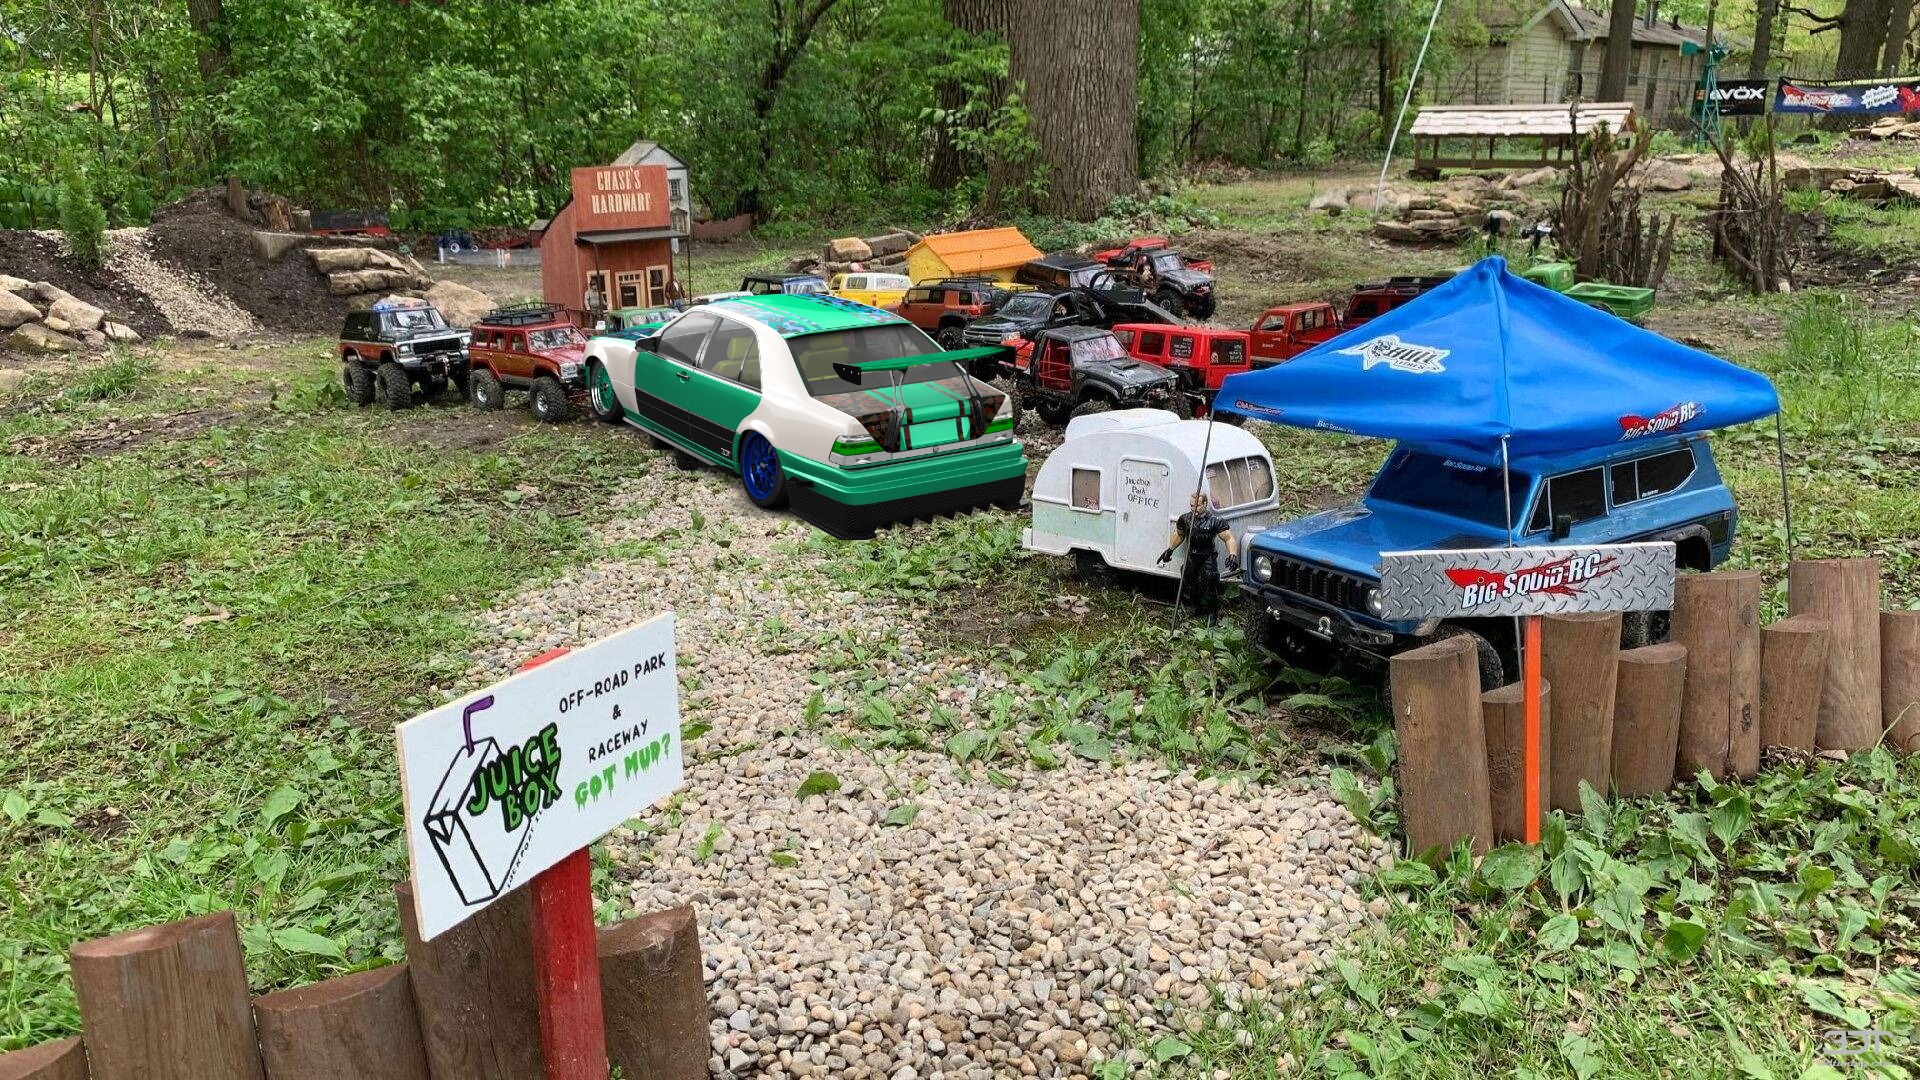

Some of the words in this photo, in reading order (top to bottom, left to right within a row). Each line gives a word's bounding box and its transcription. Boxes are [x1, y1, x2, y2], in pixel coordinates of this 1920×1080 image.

[591, 192, 651, 214] HARDWARE
[596, 165, 641, 190] CHASE'S
[1127, 493, 1160, 509] OFFICE
[1460, 582, 1498, 610] BIG
[1567, 552, 1601, 584] RC
[559, 669, 629, 714] OFF-ROAD
[634, 651, 667, 679] PARK
[612, 703, 622, 721] &
[588, 718, 649, 764] RACEWAY
[466, 722, 562, 817] JUICE
[574, 763, 617, 814] GOT
[623, 732, 671, 783] MUD?
[501, 764, 563, 833] BOX
